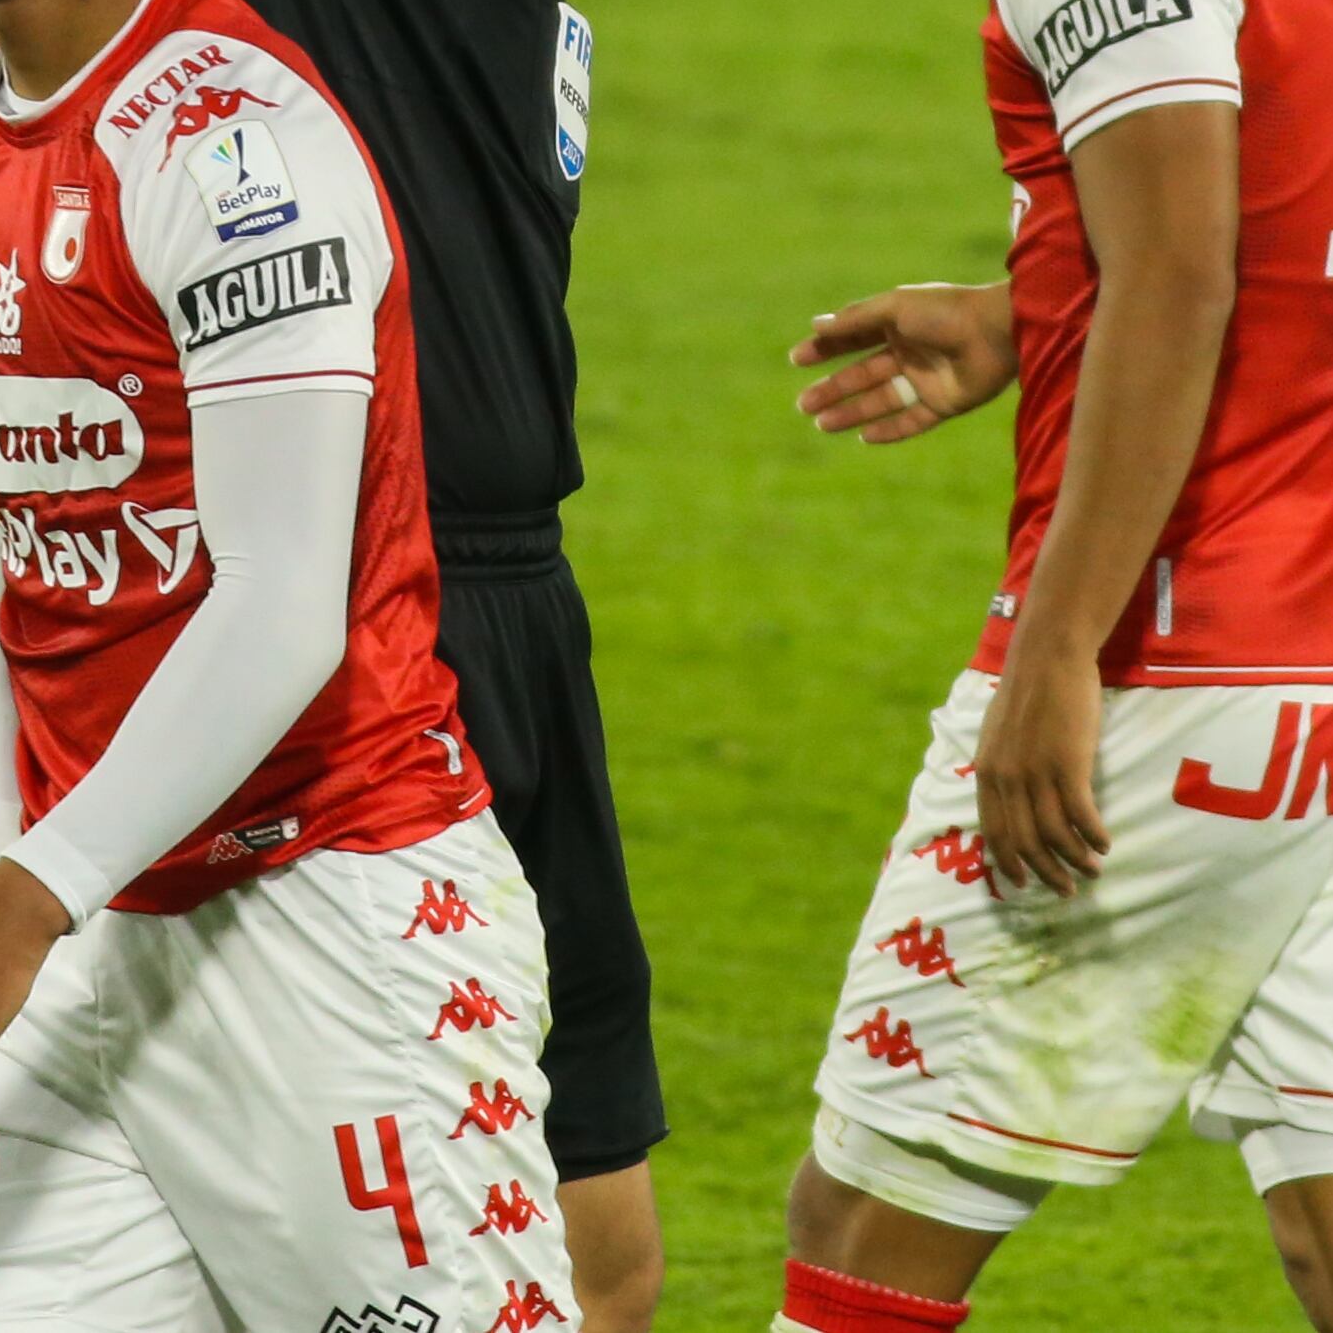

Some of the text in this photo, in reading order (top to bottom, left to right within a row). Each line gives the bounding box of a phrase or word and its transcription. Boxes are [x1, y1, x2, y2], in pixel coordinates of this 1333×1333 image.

[107, 44, 233, 140] NECTAR
[217, 182, 282, 215] BetPlay
[562, 137, 582, 170] 2021
[188, 243, 345, 346] AGUILA
[333, 1114, 430, 1270] 4
